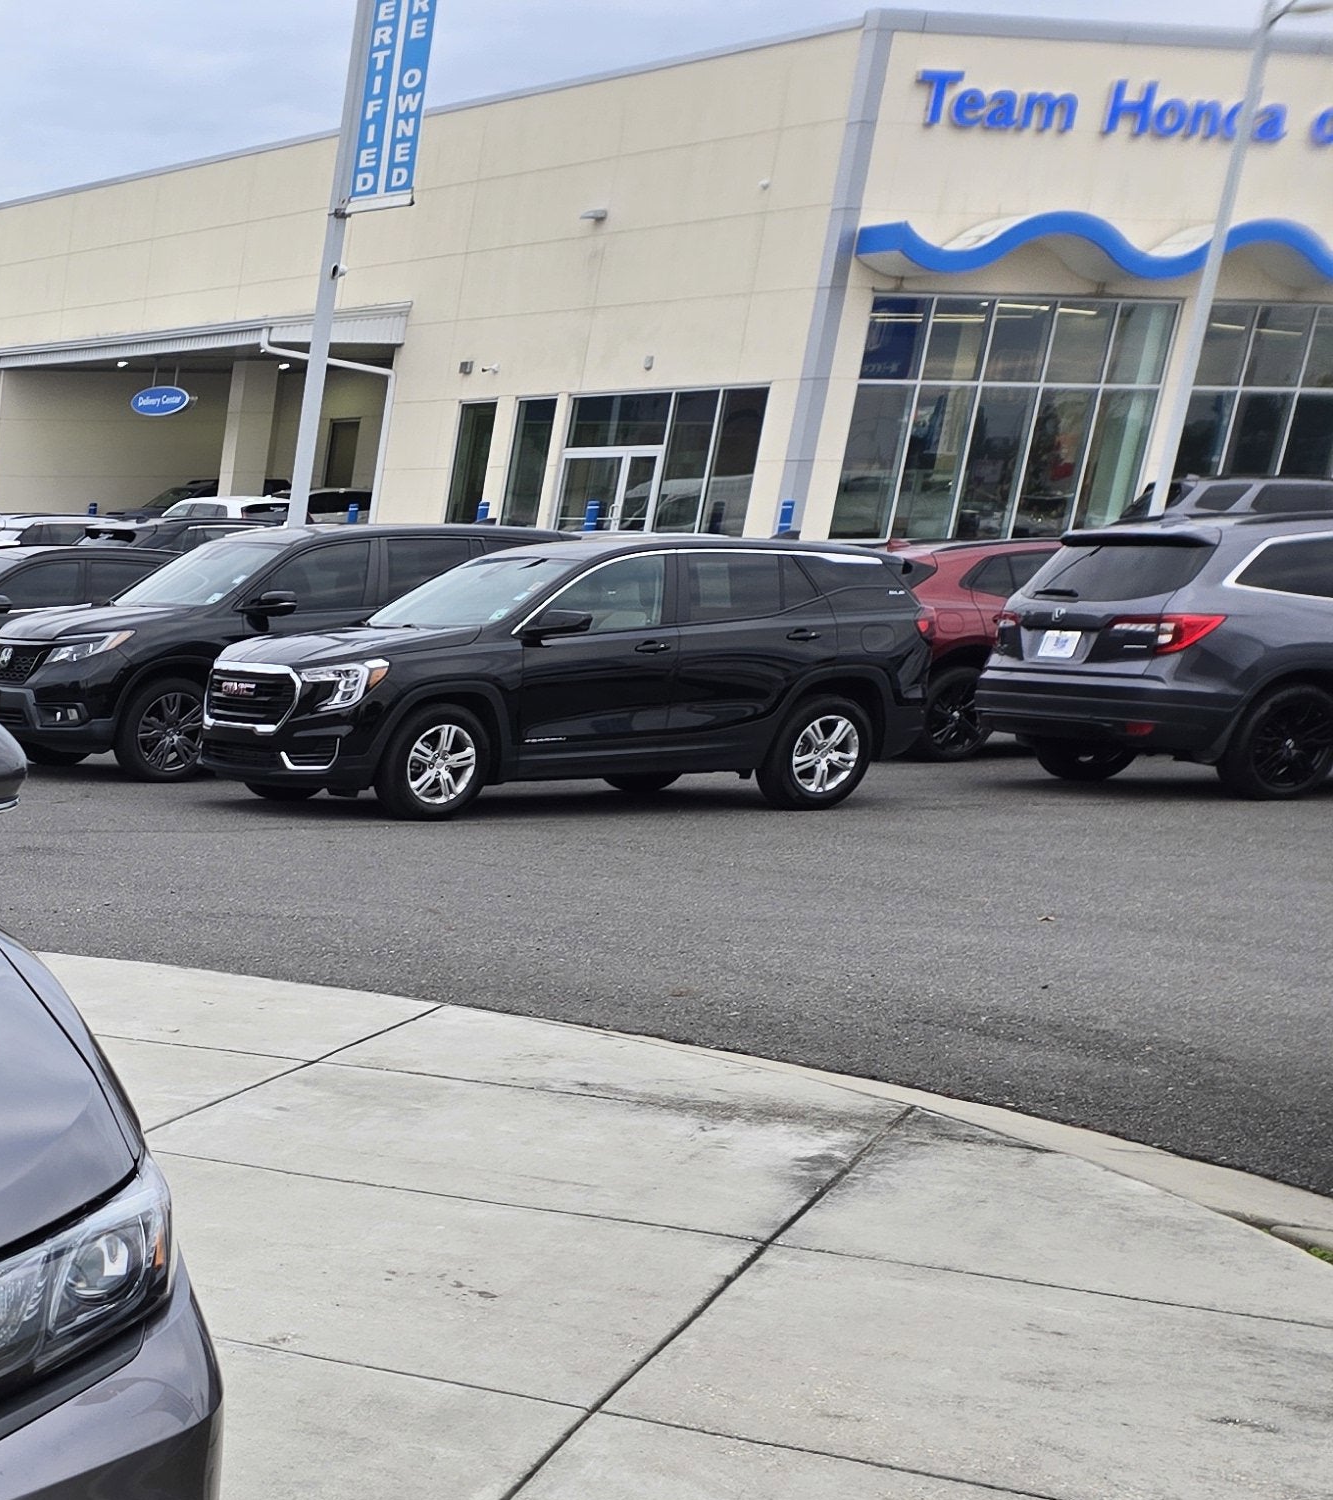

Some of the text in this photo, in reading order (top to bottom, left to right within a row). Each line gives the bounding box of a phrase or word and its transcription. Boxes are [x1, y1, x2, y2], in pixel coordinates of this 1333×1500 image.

[918, 69, 1079, 134] Team
[391, 68, 423, 189] OWNED
[138, 394, 182, 407] Delivery Center
[221, 681, 257, 696] GMC
